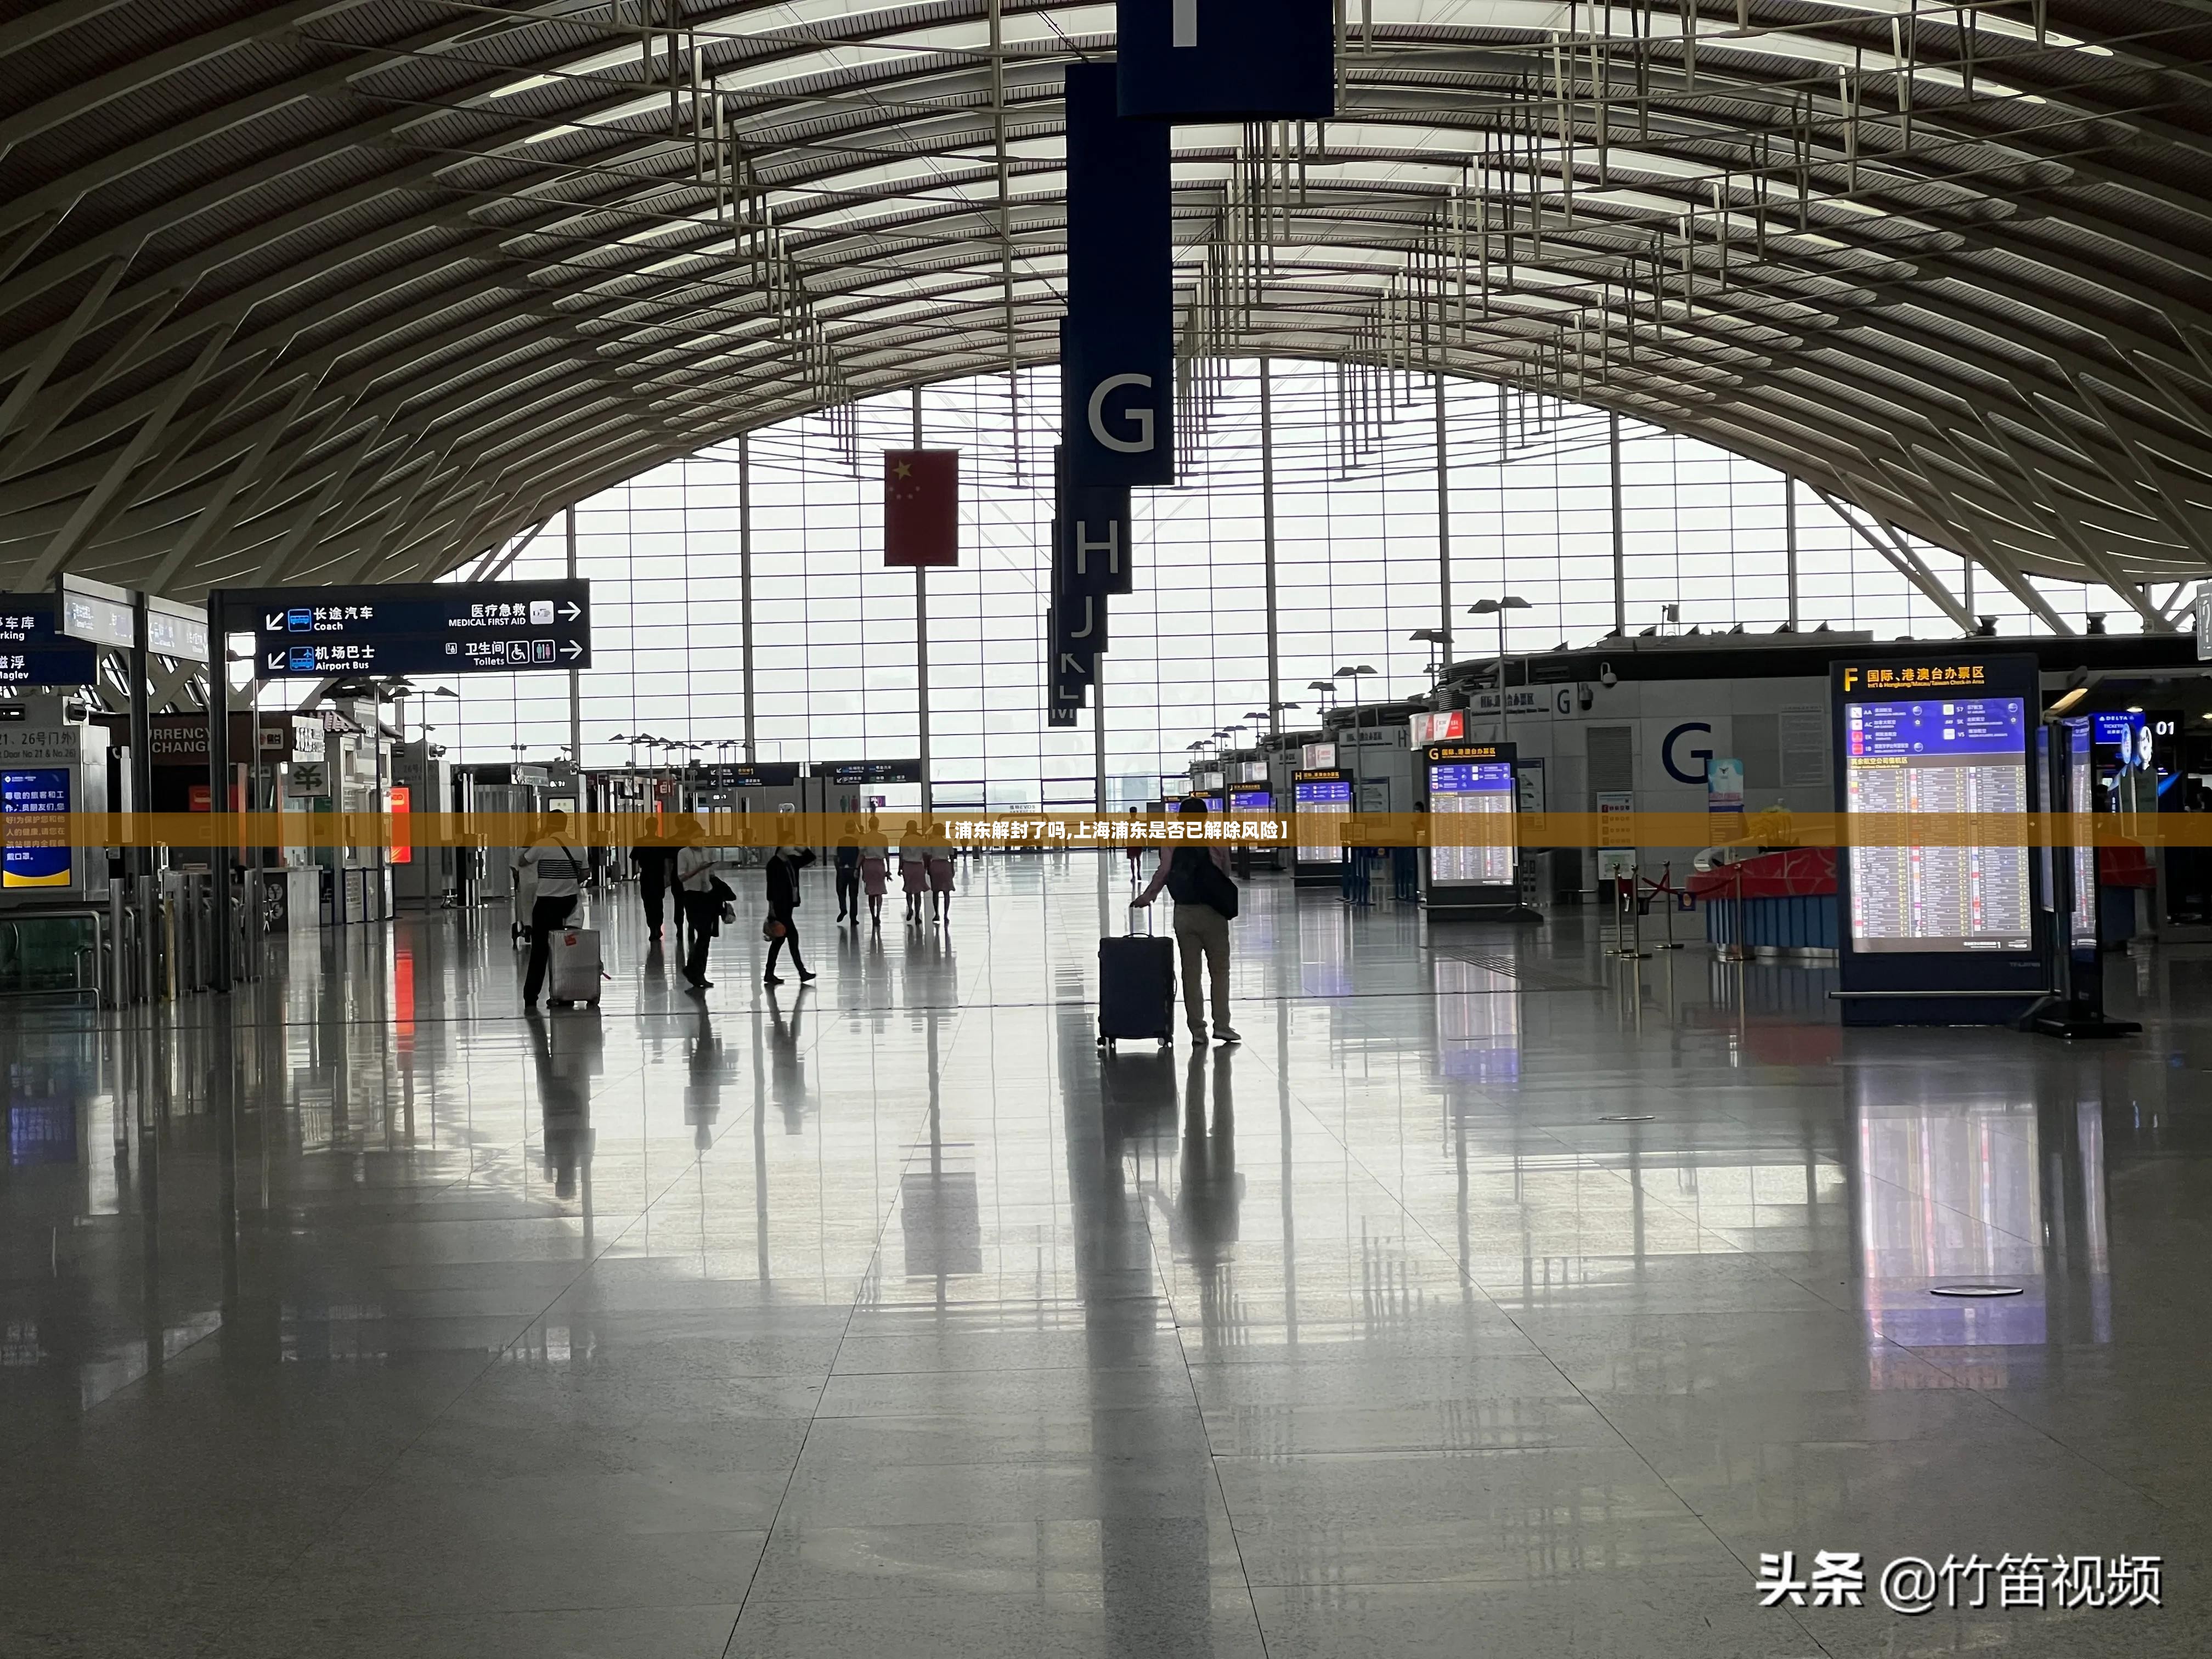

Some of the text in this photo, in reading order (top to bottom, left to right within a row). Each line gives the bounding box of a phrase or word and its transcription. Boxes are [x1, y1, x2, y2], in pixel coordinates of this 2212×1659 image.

[1088, 373, 1155, 453] G
[1076, 520, 1118, 574] H
[313, 606, 373, 620] 长途汽车
[471, 603, 526, 618] 医疗急救
[1071, 596, 1093, 637] J
[0, 616, 35, 630] 车库
[314, 622, 343, 631] Coach
[449, 618, 486, 627] MEDICAL
[488, 618, 510, 626] FIRST
[315, 645, 375, 660] 机场巴士
[465, 641, 505, 656] 卫生间
[315, 661, 369, 672] Airport Bus
[473, 657, 505, 666] Toilets
[1061, 653, 1086, 673] K
[0, 670, 29, 681] aglev
[1844, 668, 1858, 692] F
[1867, 666, 1985, 682] 国际、港澳台办票区
[1059, 685, 1079, 699] L
[1557, 689, 1571, 714] G
[2156, 721, 2174, 735] 01
[1429, 748, 1439, 760] G
[1662, 722, 1713, 785] G
[1295, 772, 1302, 780] H
